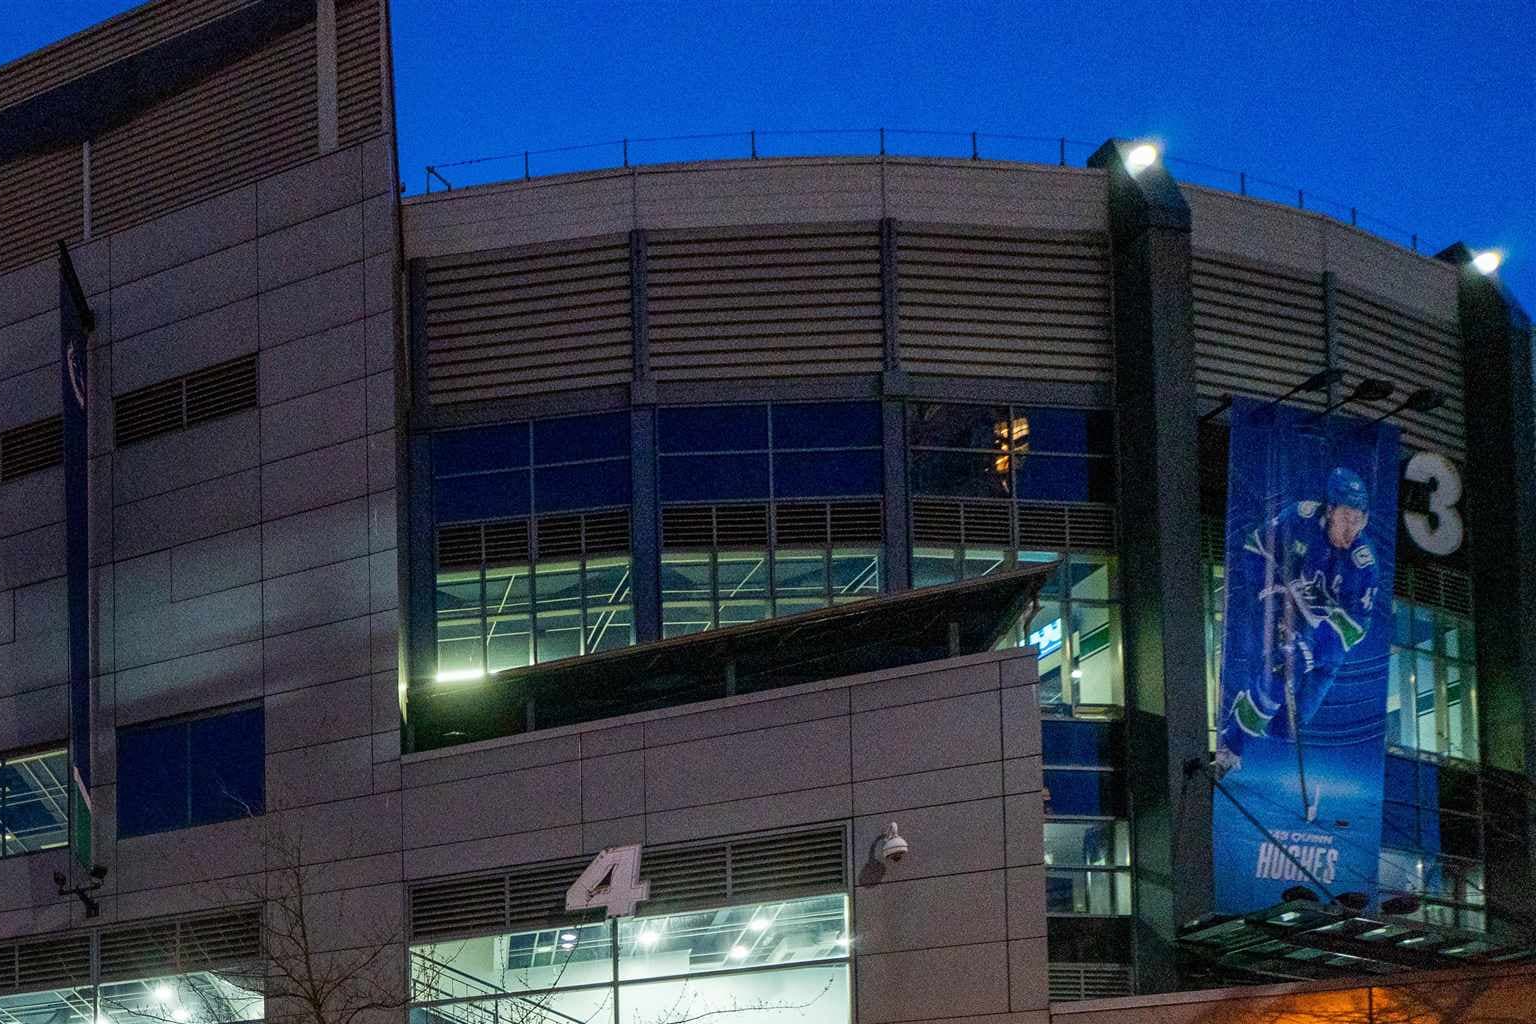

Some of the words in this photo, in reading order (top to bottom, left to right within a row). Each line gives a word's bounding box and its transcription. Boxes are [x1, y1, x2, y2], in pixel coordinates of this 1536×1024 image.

[1402, 451, 1464, 555] 3
[565, 844, 651, 917] 4
[1256, 841, 1339, 884] HUGHES
